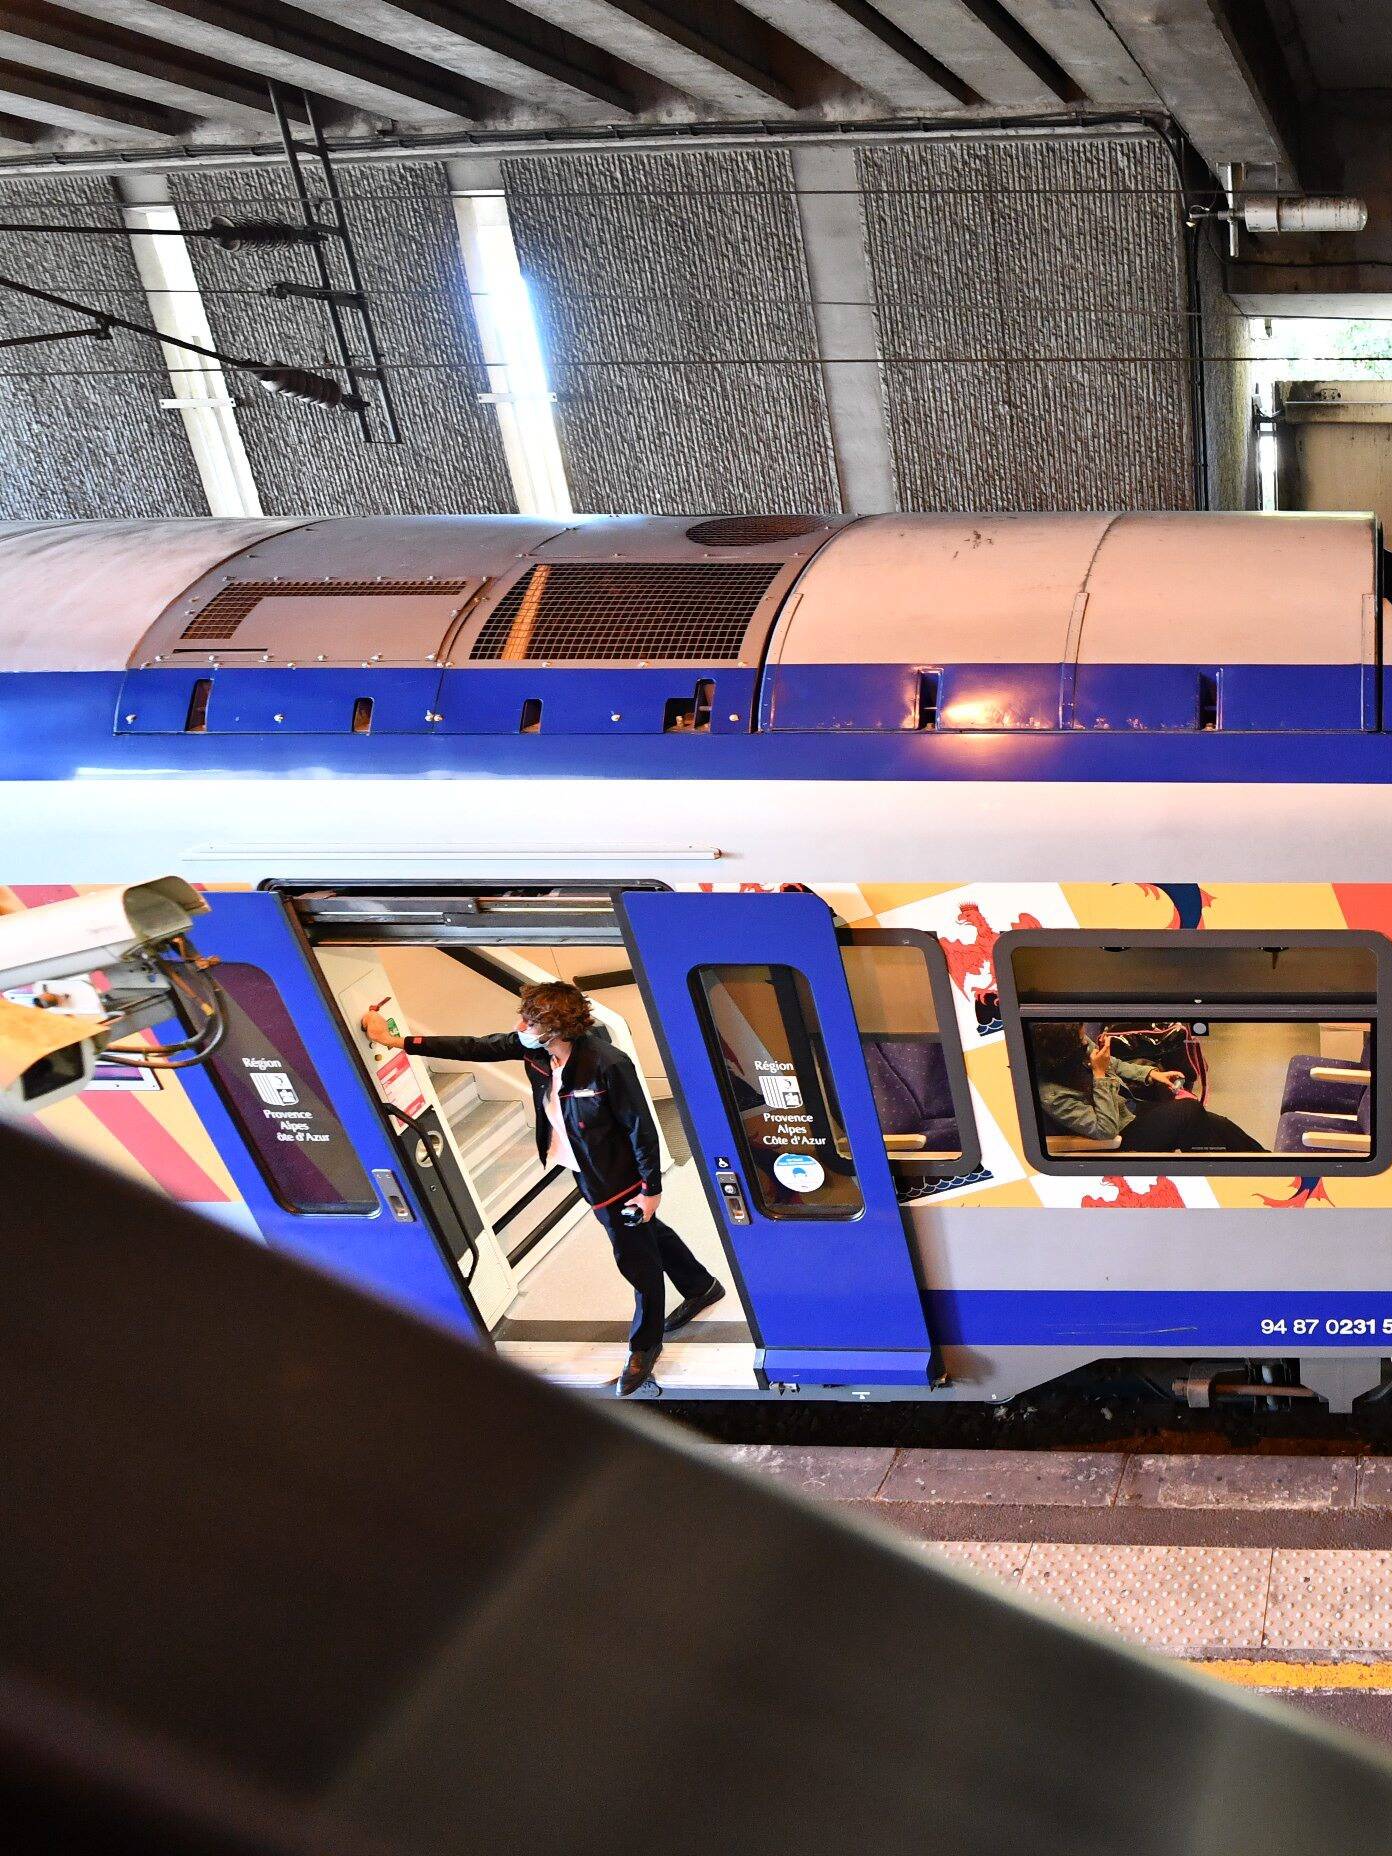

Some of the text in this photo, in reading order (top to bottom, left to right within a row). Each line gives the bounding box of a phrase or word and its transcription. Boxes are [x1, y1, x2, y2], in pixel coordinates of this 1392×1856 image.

[242, 1057, 282, 1070] Région
[754, 1060, 795, 1073] Région
[263, 1109, 313, 1119] Provence
[763, 1112, 814, 1123] Provence
[280, 1120, 310, 1132] Alpes
[777, 1124, 807, 1136] Alpes
[762, 1135, 826, 1145] Côte d'Azur
[1260, 1319, 1288, 1335] 94
[1293, 1319, 1320, 1335] 87
[1325, 1319, 1376, 1335] 0231
